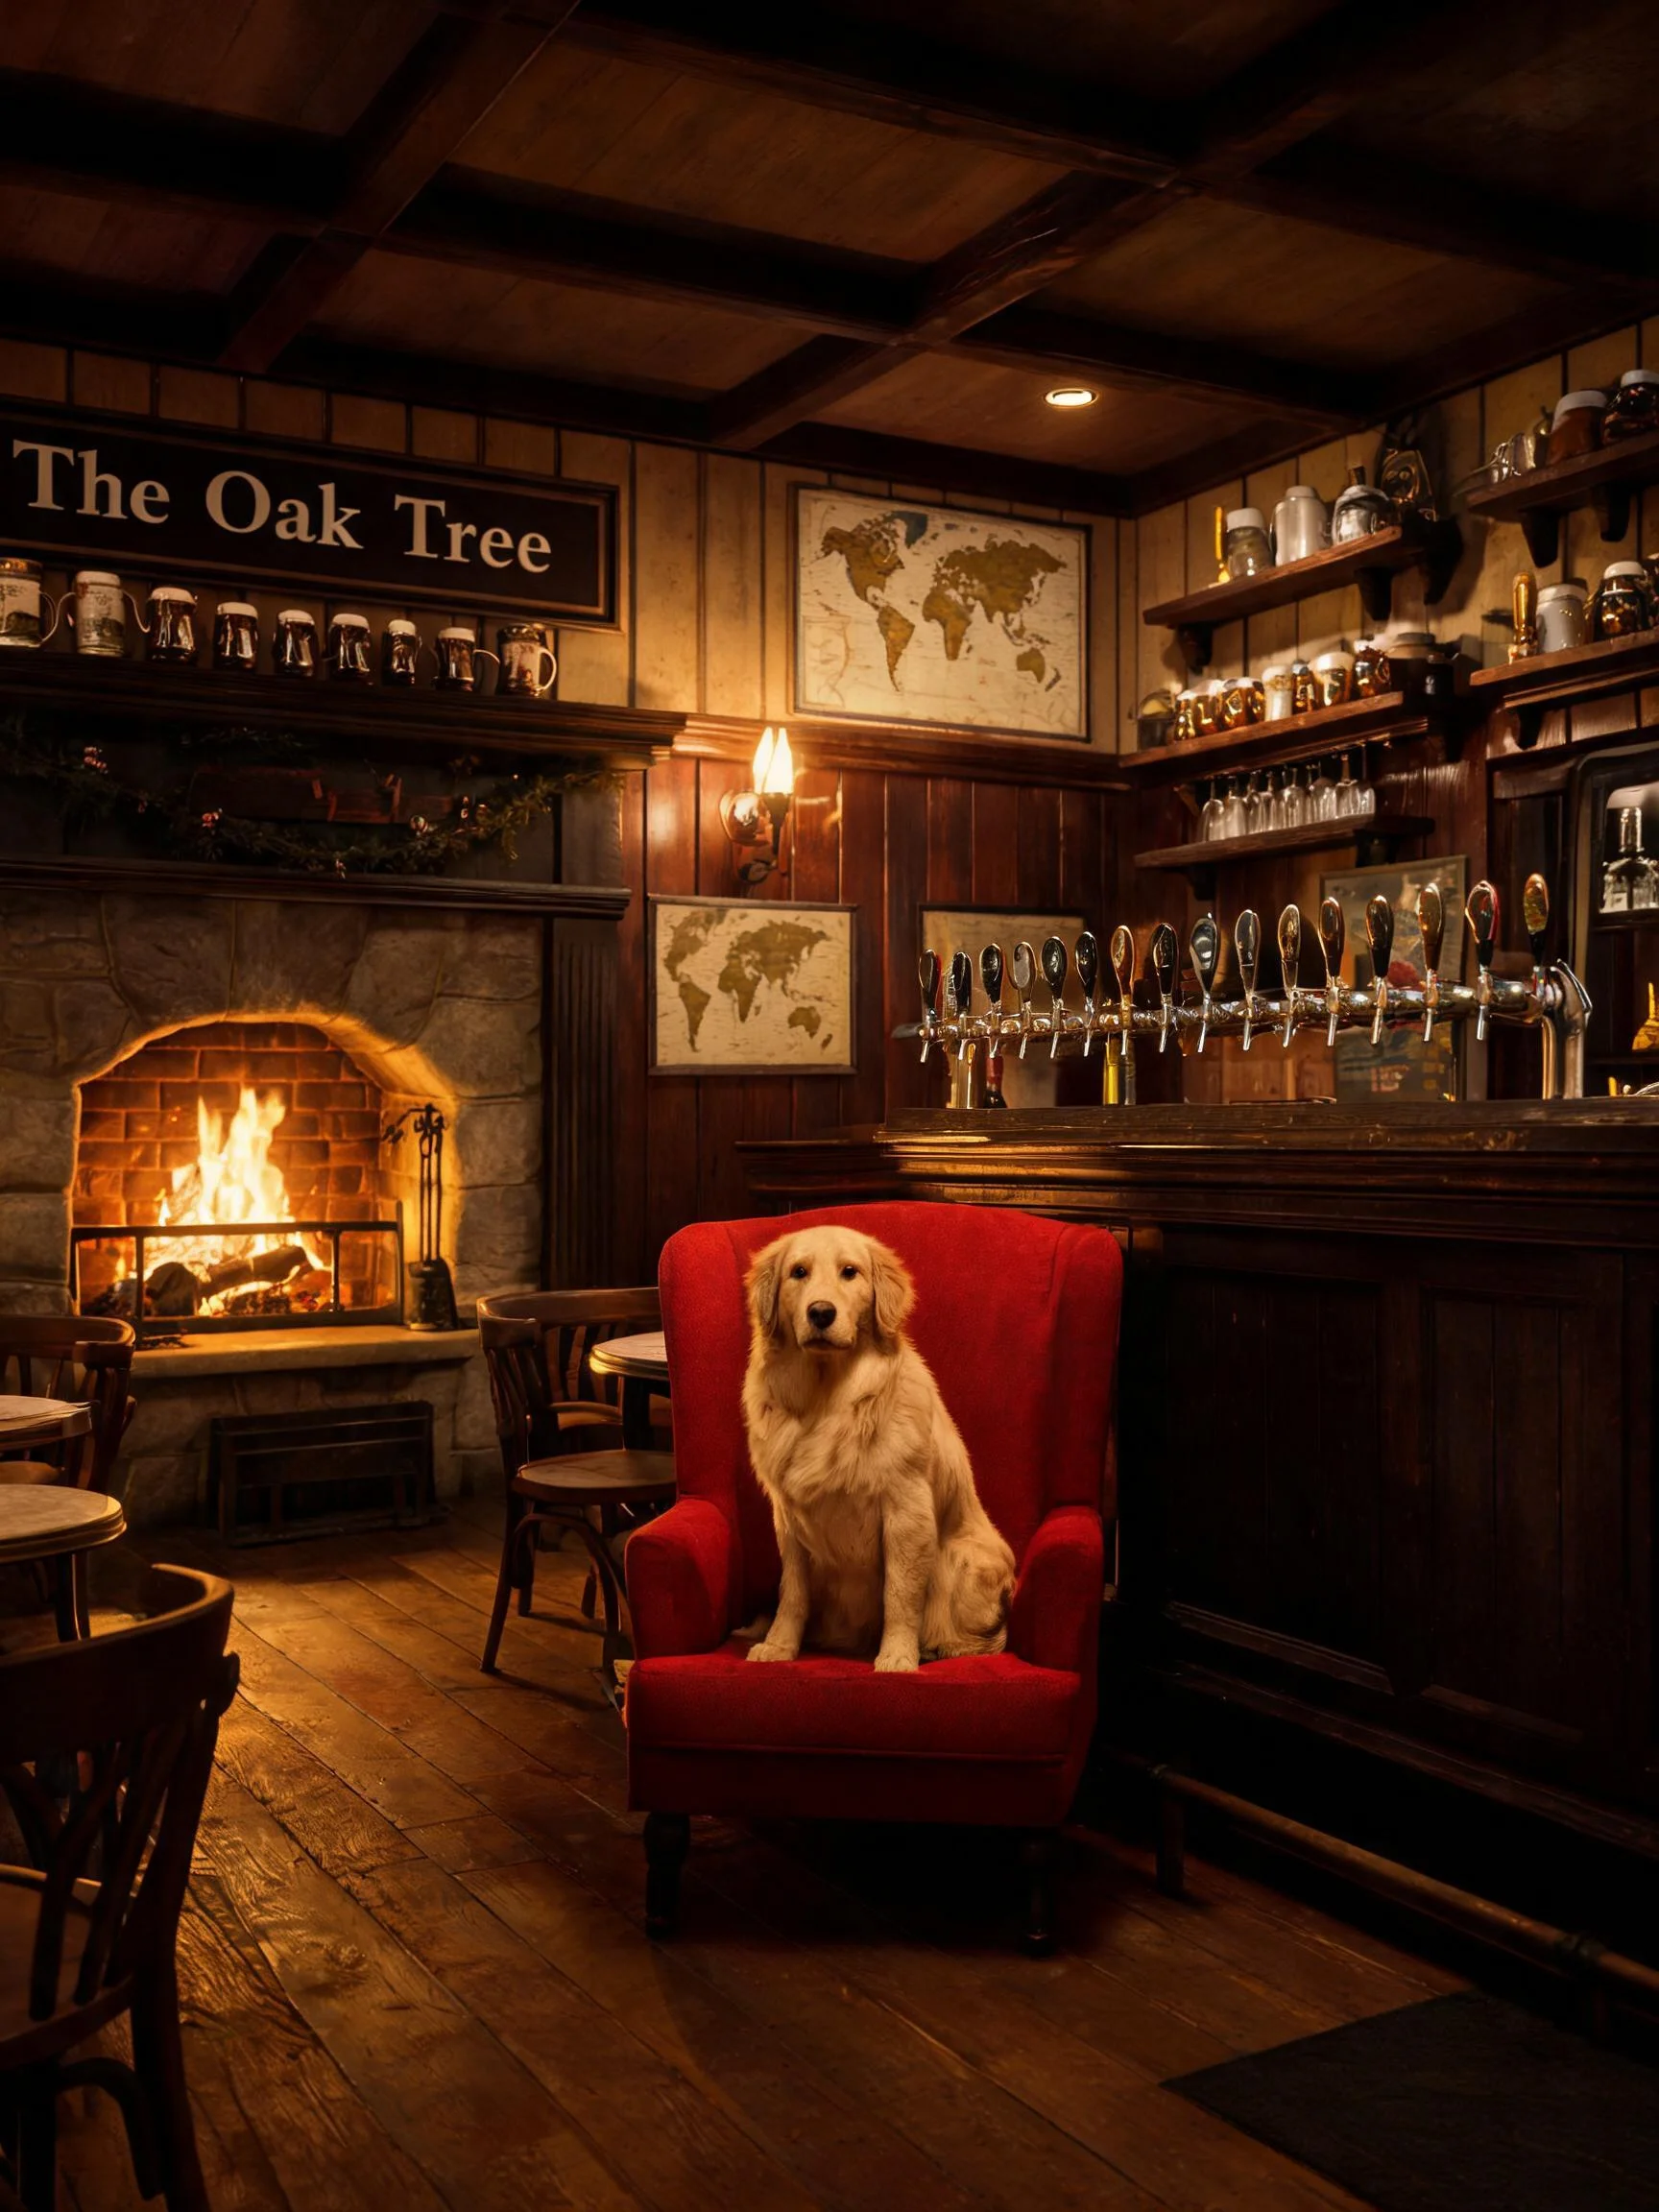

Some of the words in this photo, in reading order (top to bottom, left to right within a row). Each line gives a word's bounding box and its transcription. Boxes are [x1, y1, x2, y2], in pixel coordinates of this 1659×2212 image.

[12, 439, 170, 524] The
[205, 469, 364, 549] Oak
[395, 493, 552, 573] Tree
